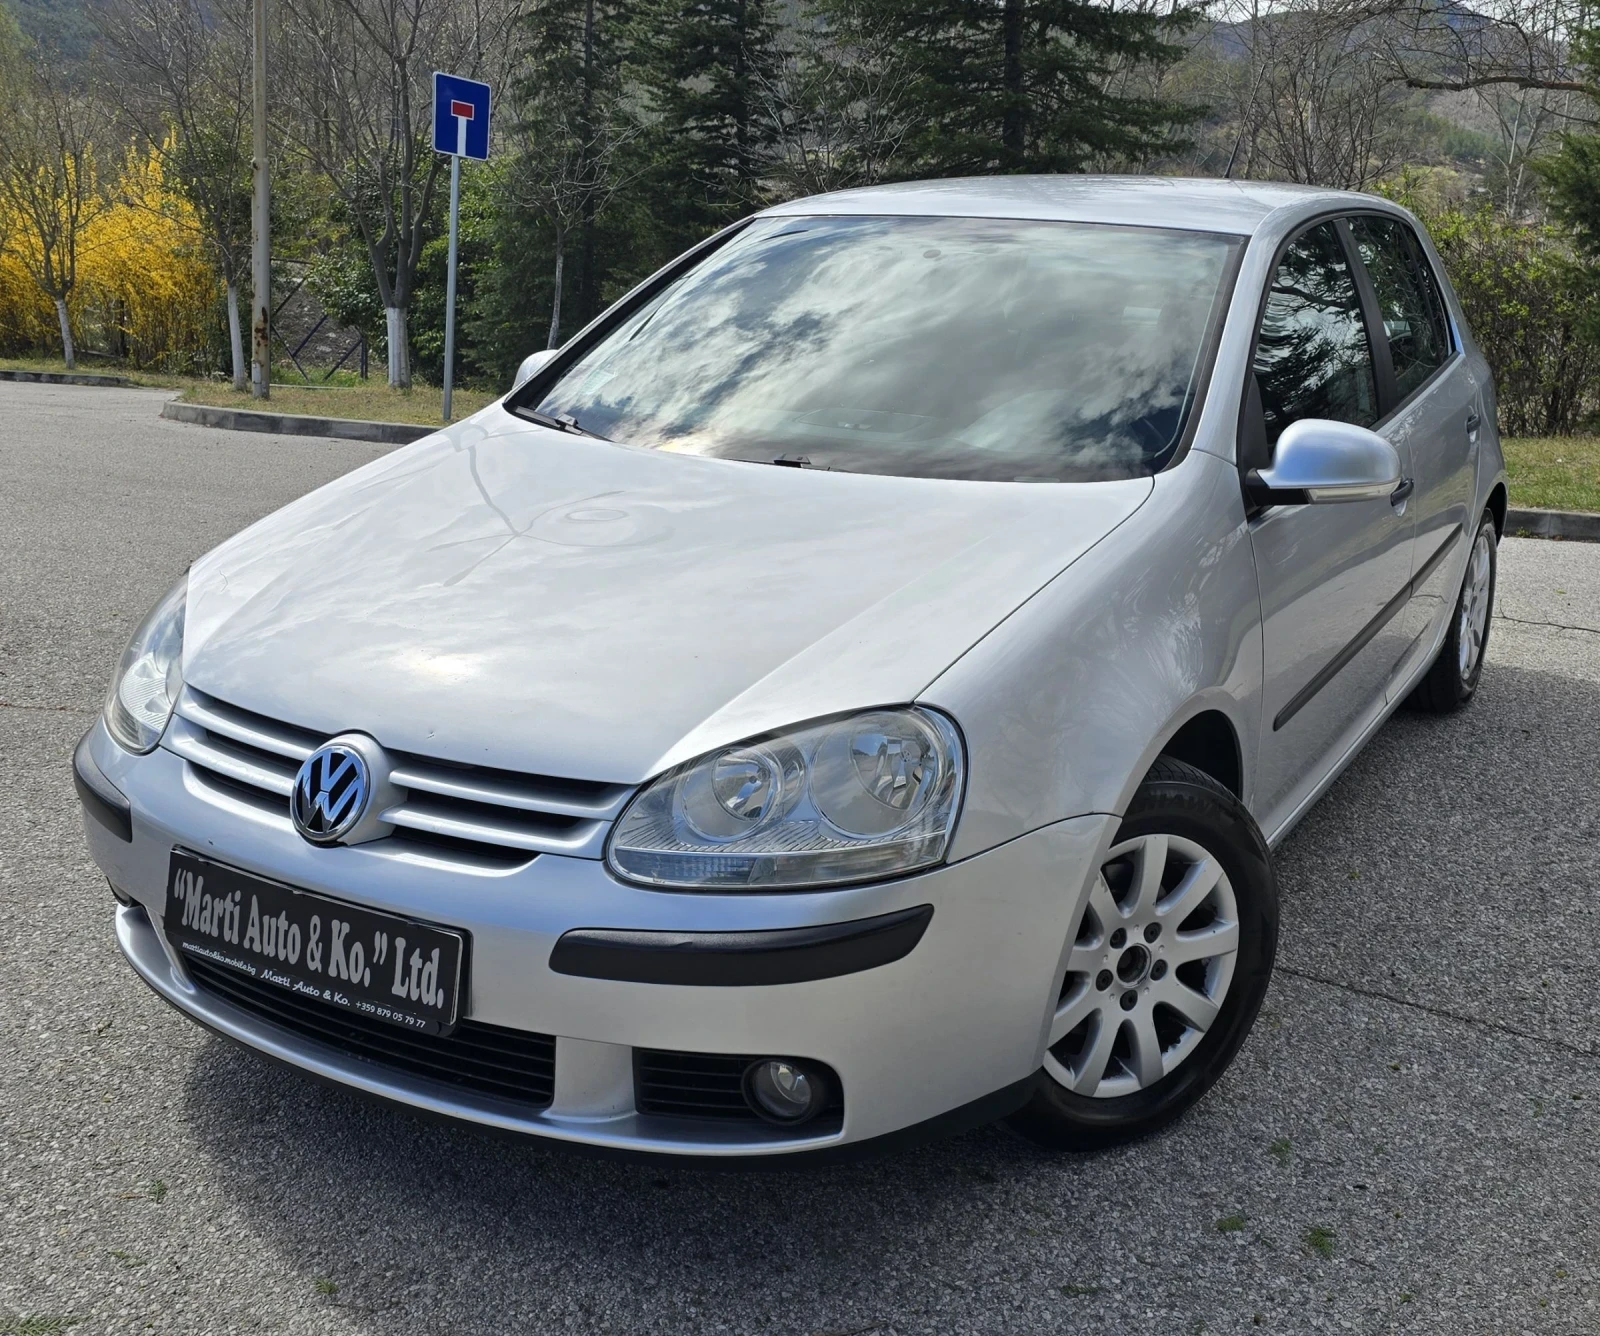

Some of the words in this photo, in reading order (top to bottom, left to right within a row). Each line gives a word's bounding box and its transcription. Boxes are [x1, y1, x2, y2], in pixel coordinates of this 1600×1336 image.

[294, 745, 367, 837] VW
[243, 894, 301, 965] Auto
[306, 914, 323, 973] &
[391, 936, 445, 1009] Ltd.
[260, 969, 290, 987] Marti
[292, 981, 320, 997] Auto
[322, 990, 332, 1001] &
[333, 991, 351, 1006] Ko.
[355, 1000, 376, 1013] +359
[376, 1007, 391, 1018] 879
[392, 1011, 403, 1021] 05
[404, 1015, 415, 1025] 79
[416, 1018, 426, 1029] 77
